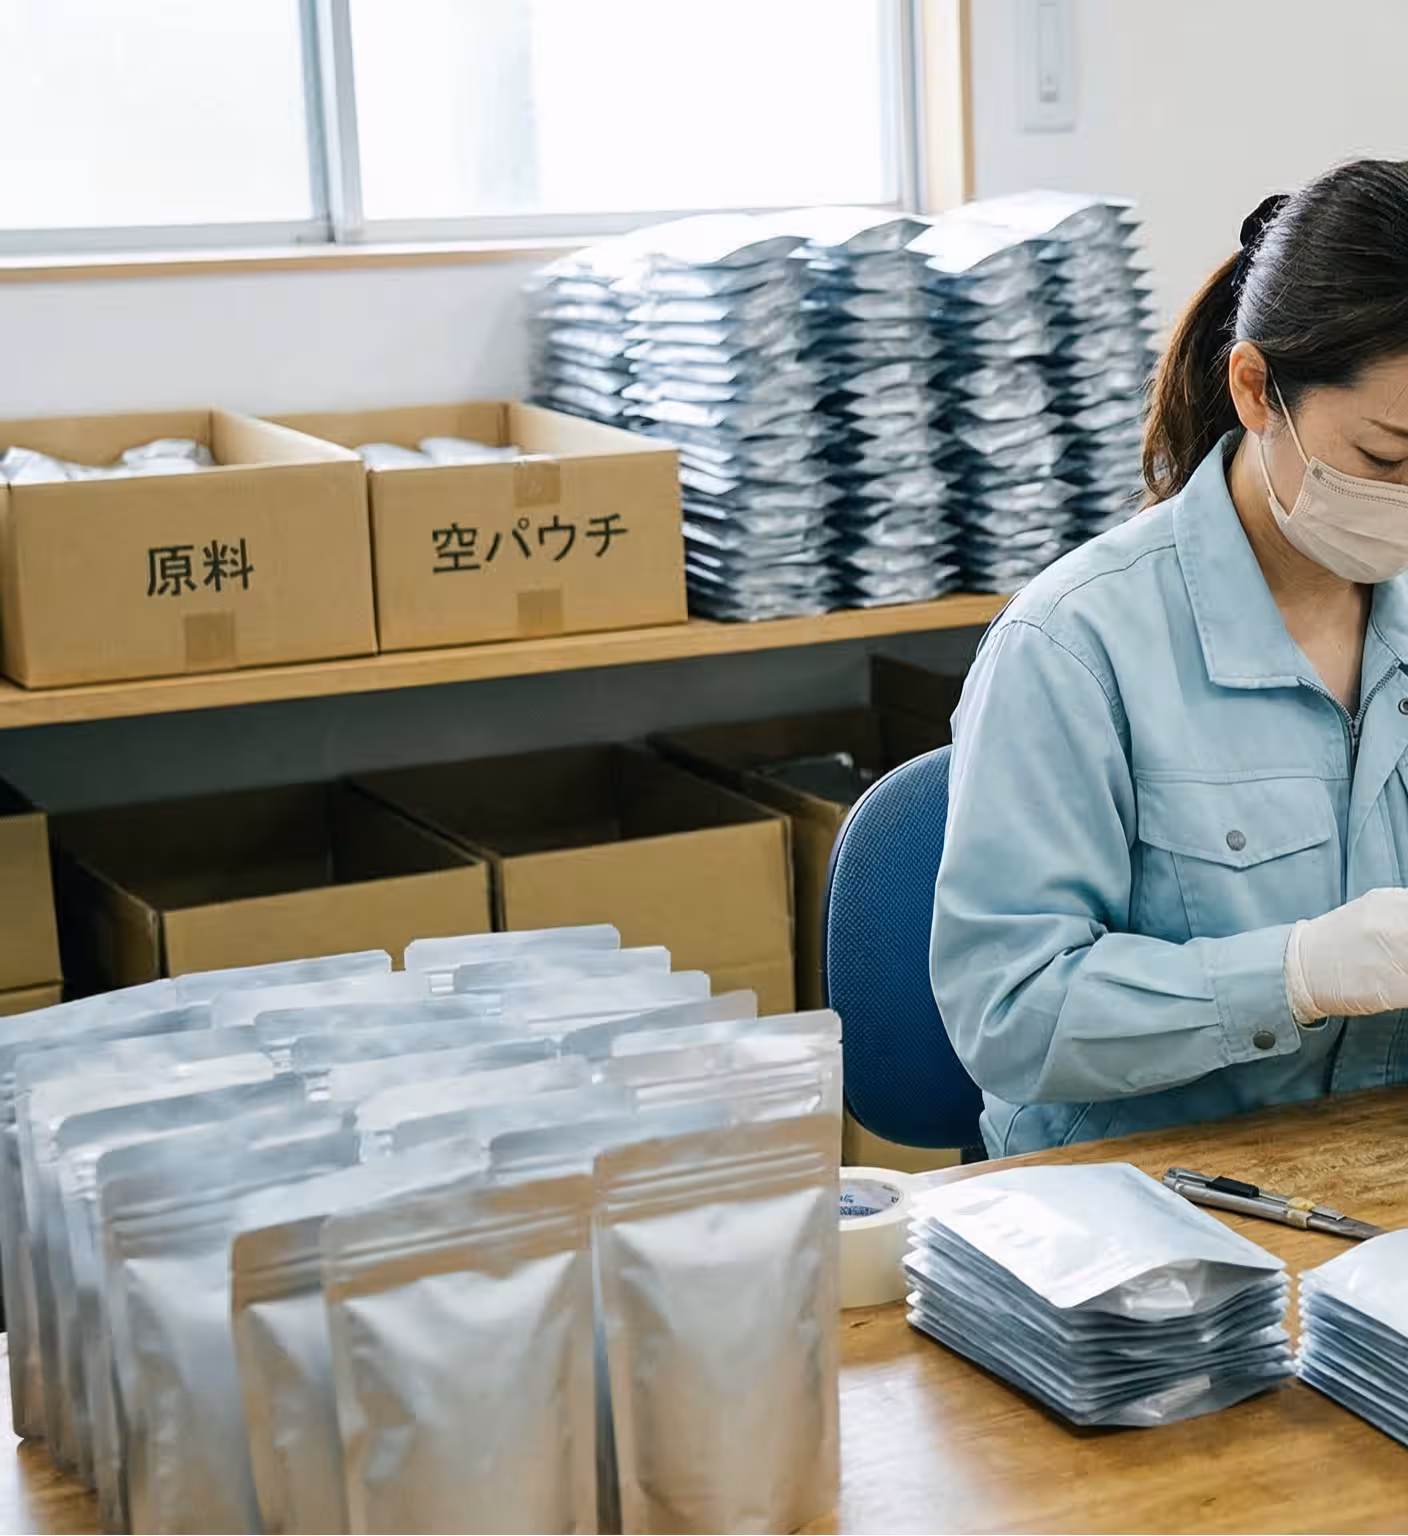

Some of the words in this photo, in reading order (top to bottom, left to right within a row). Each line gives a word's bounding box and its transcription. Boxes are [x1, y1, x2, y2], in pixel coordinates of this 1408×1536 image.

[146, 538, 255, 597] 原料
[431, 513, 629, 574] 空パウチ
